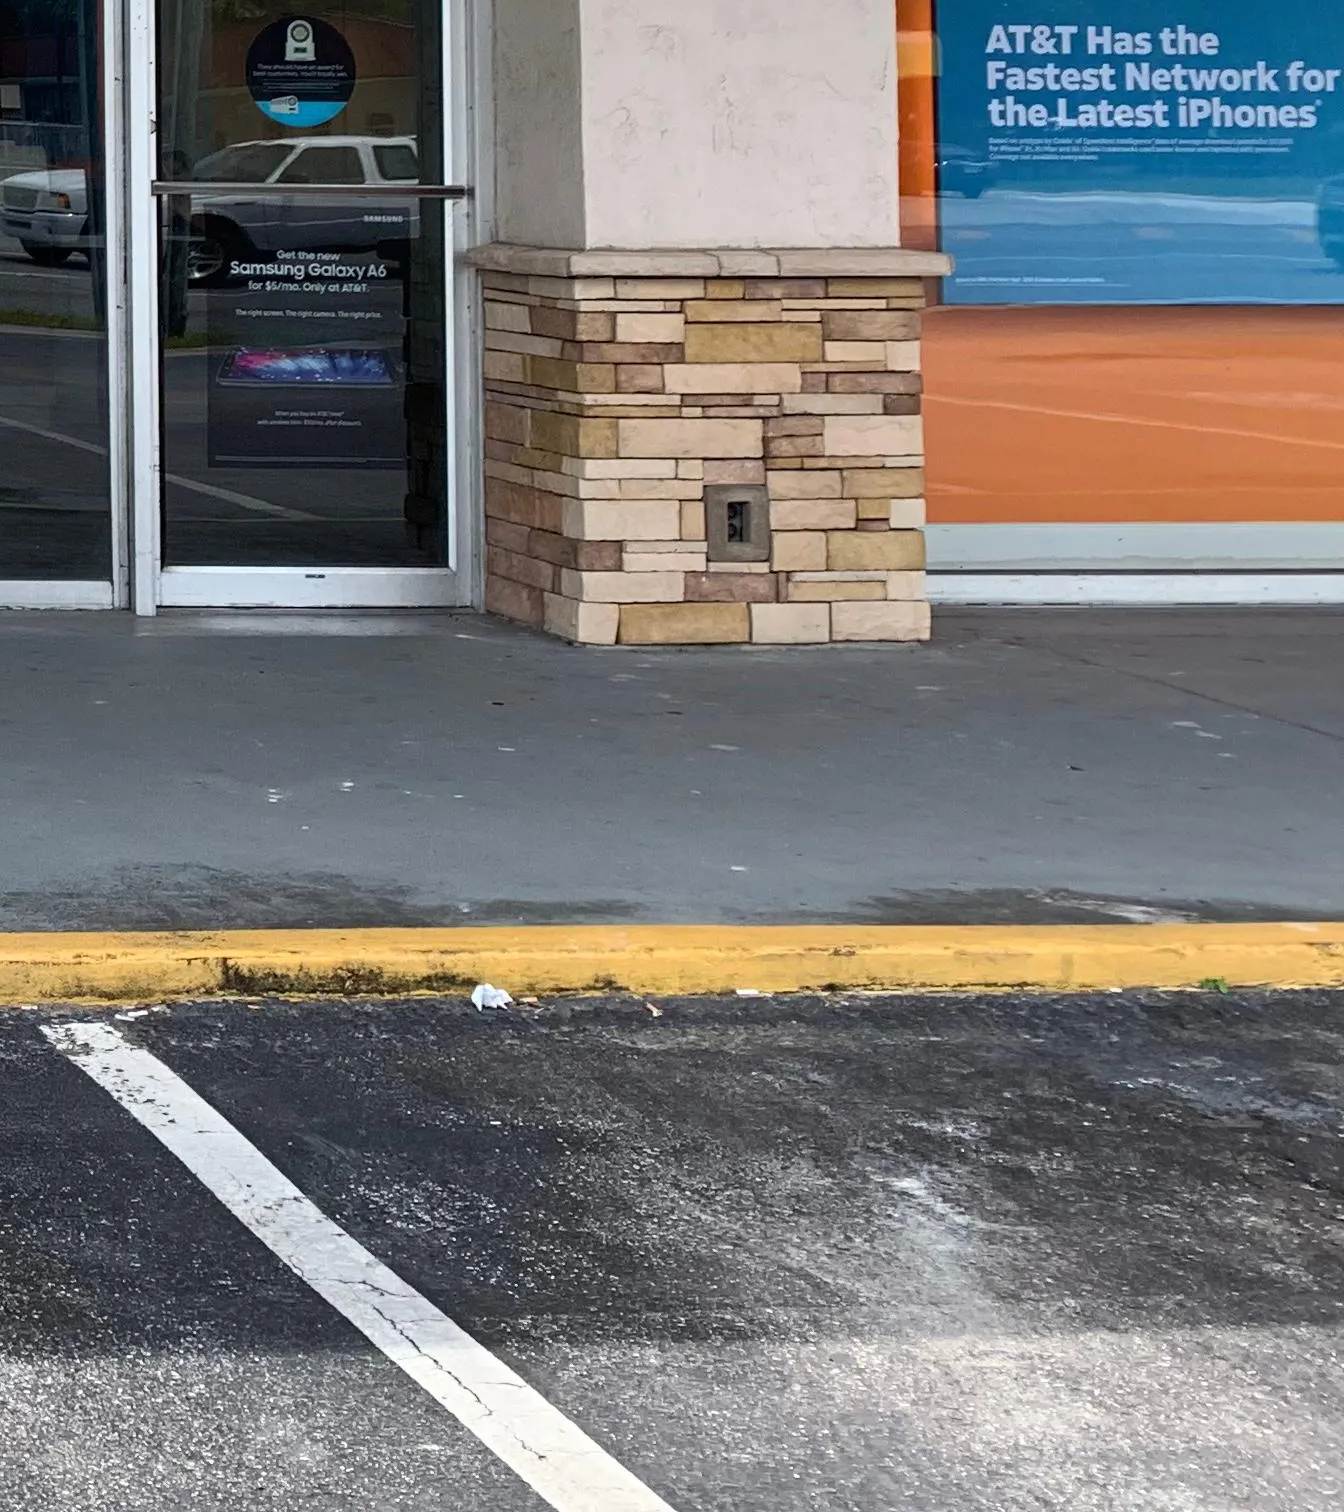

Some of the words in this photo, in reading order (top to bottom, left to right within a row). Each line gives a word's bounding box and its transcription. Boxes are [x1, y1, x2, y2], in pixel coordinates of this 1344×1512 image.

[985, 24, 1079, 54] AT&T
[1087, 25, 1153, 55] Has
[1160, 24, 1220, 55] the
[986, 61, 1117, 91] Fastest
[1125, 61, 1280, 92] Network
[1286, 60, 1341, 92] for
[988, 96, 1048, 127] the
[1059, 98, 1170, 127] Latest
[276, 250, 296, 260] Get
[298, 251, 315, 260] the
[316, 253, 341, 261] new
[230, 261, 306, 280] Samsung
[308, 263, 365, 281] Galaxy
[366, 264, 387, 278] A6
[248, 280, 263, 290] for
[302, 282, 326, 294] Only
[327, 283, 340, 292] at
